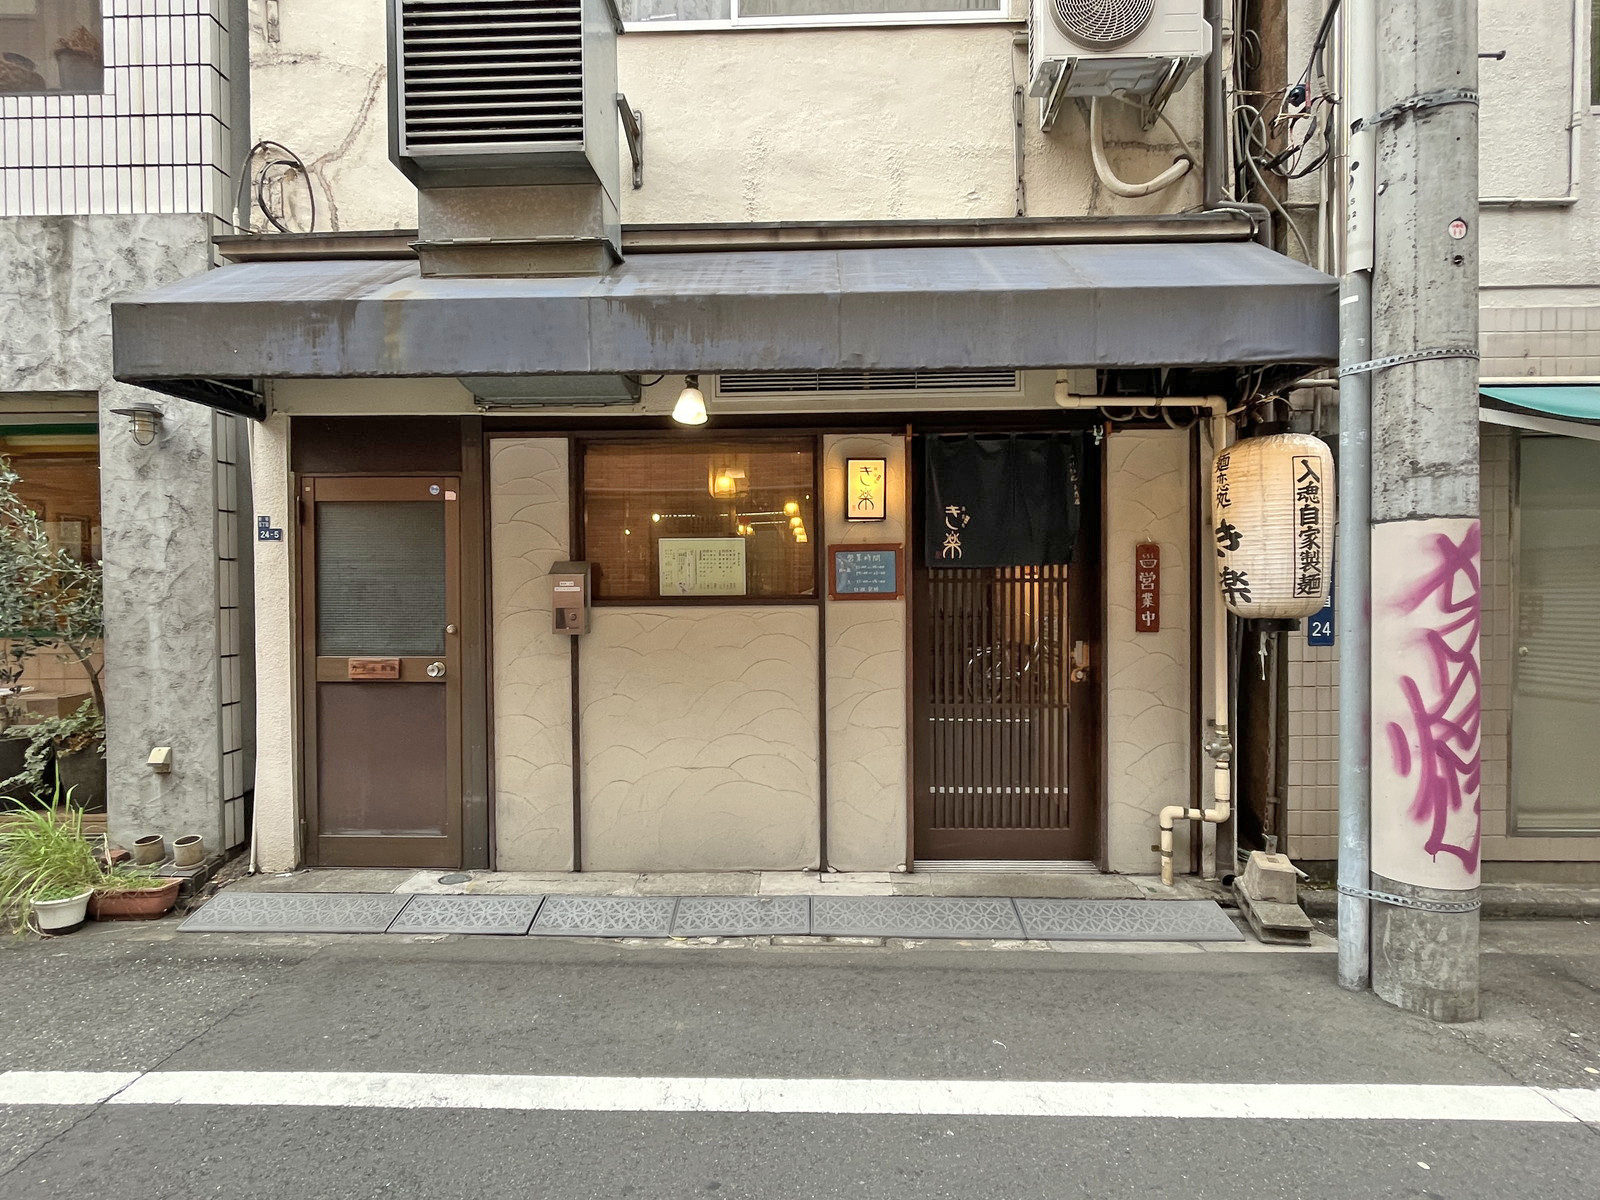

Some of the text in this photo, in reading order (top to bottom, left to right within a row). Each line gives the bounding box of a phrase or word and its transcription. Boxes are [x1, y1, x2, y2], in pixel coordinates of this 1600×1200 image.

[260, 530, 280, 539] 24-5
[1297, 459, 1322, 596] 入魂自家製麺
[1139, 571, 1156, 627] 営業中
[1312, 621, 1331, 636] 24
